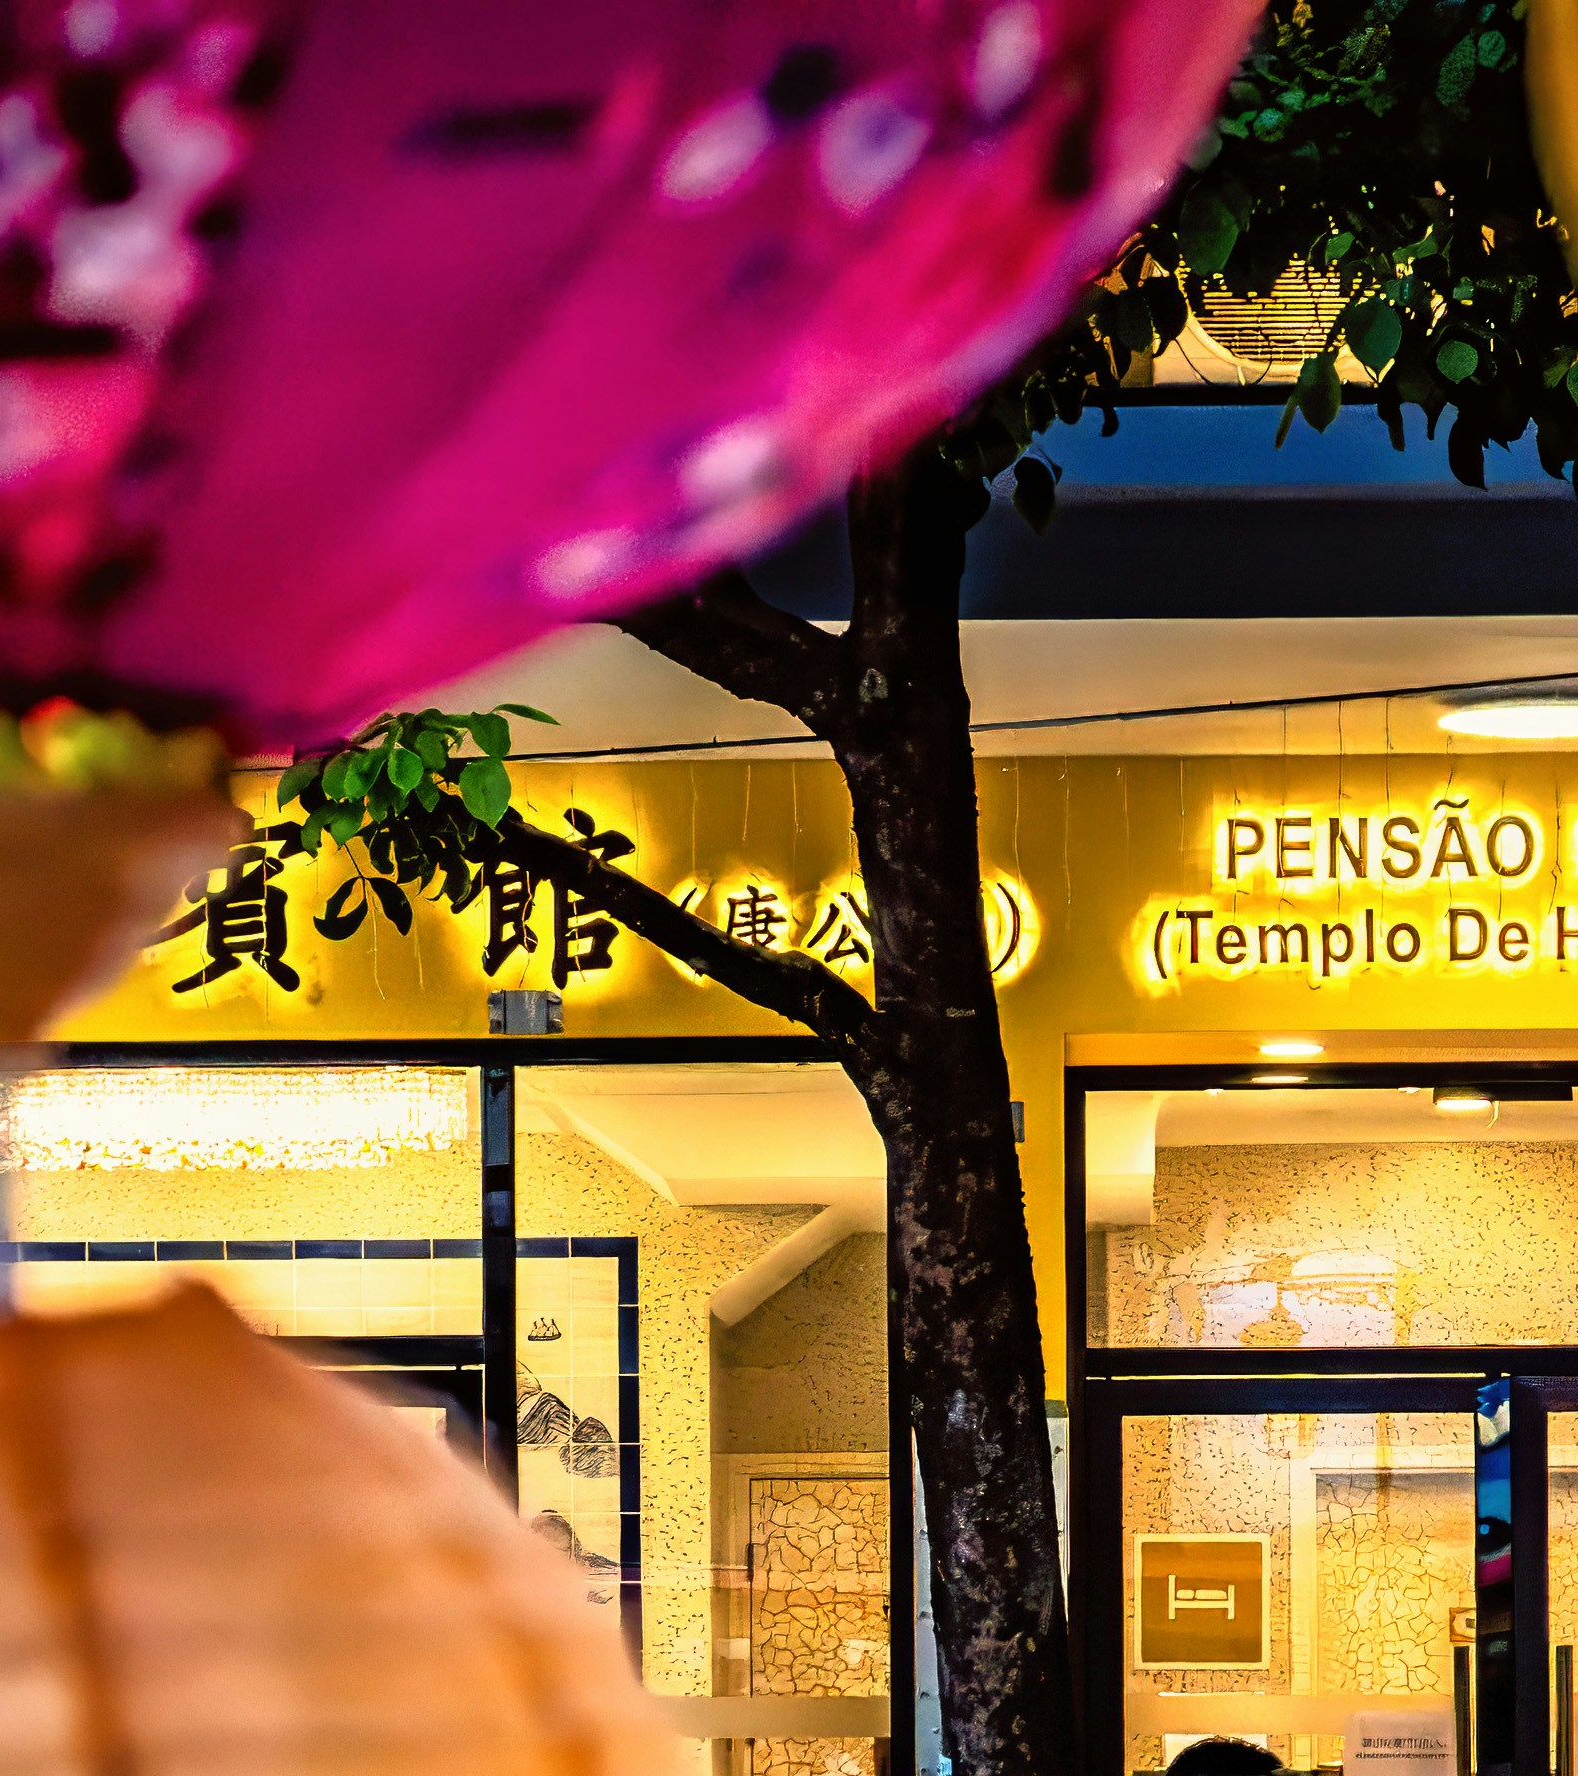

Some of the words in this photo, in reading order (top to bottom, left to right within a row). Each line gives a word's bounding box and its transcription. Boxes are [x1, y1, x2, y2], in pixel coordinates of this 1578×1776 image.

[1225, 797, 1537, 880] PENSÃO
[1153, 909, 1422, 981] (Templo
[1448, 908, 1531, 962] De
